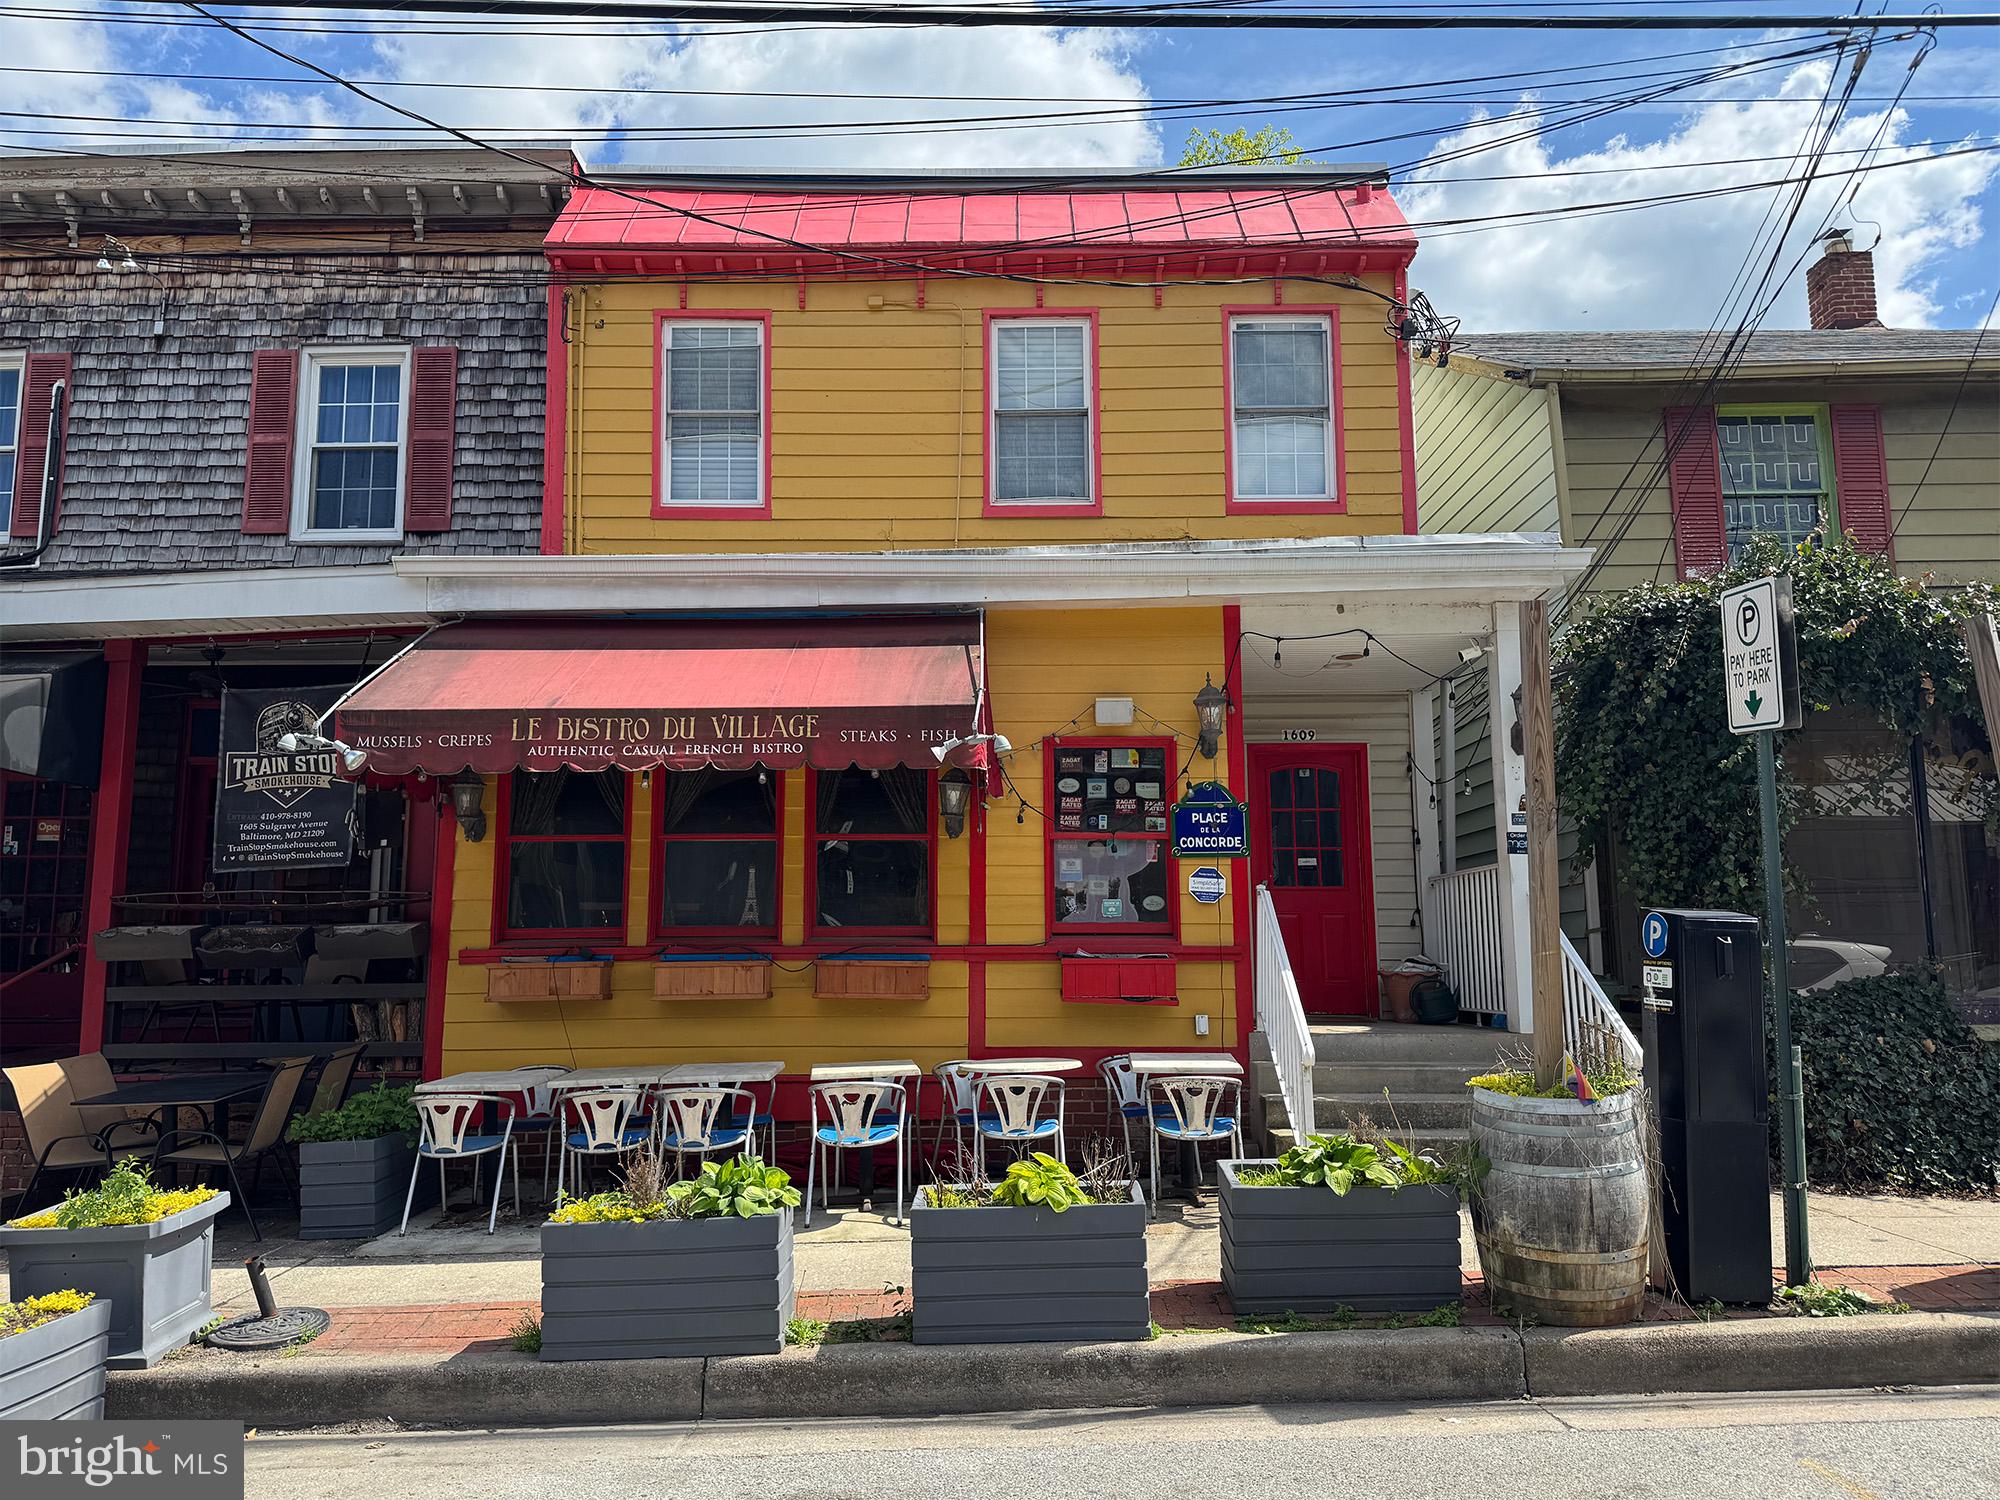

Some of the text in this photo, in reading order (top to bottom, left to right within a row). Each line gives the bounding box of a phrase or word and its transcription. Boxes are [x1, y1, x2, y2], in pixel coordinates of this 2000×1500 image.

[1730, 647, 1772, 671] PAY HERE
[1734, 667, 1770, 688] TO PARK
[511, 714, 820, 743] LE BISTRO DU VILLAGE
[1283, 730, 1315, 740] 1609
[356, 734, 492, 748] MUSSELS CREPES
[840, 729, 957, 742] STEAKS FISH
[527, 743, 803, 756] AUTHENTIC CASUAL FRENCH BISTRO
[233, 756, 289, 780] TRAIN
[255, 775, 321, 788] SMOKEHOUSE
[260, 811, 311, 821] 410-978-8190
[1191, 813, 1228, 823] PLACE
[240, 820, 328, 832] 1605 Sulgrave Avenue
[240, 829, 325, 841] Baltimore, MD 21209
[227, 840, 337, 852] TrainStopSmokehouse.com
[1180, 837, 1242, 848] CONCORDE
[248, 851, 344, 861] @TrainStopSmokehouse
[1650, 920, 1661, 949] P
